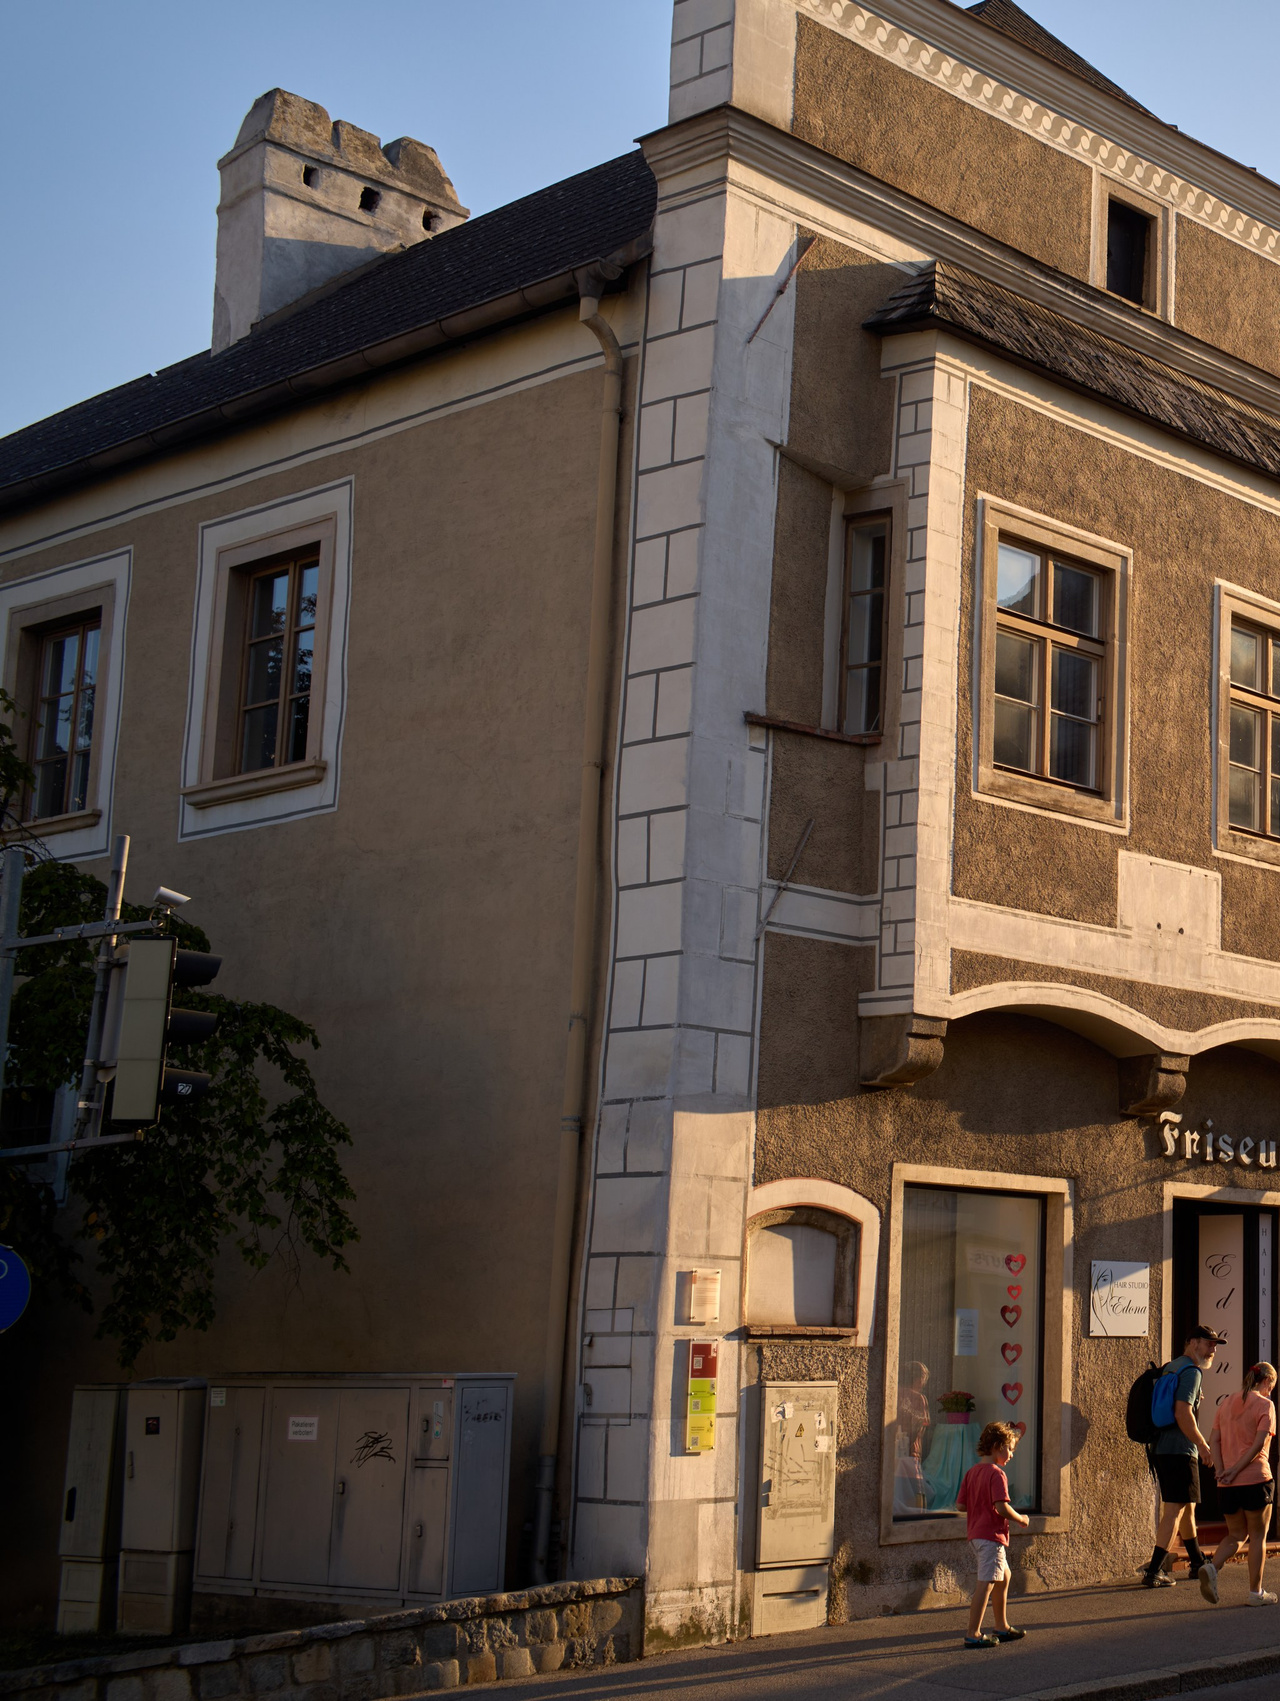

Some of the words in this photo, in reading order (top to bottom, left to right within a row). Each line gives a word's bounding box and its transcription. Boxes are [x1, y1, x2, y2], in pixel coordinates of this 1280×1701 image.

[1113, 1281, 1128, 1289] HAIR
[1128, 1281, 1149, 1290] STUDIO
[1109, 1295, 1147, 1317] Edona
